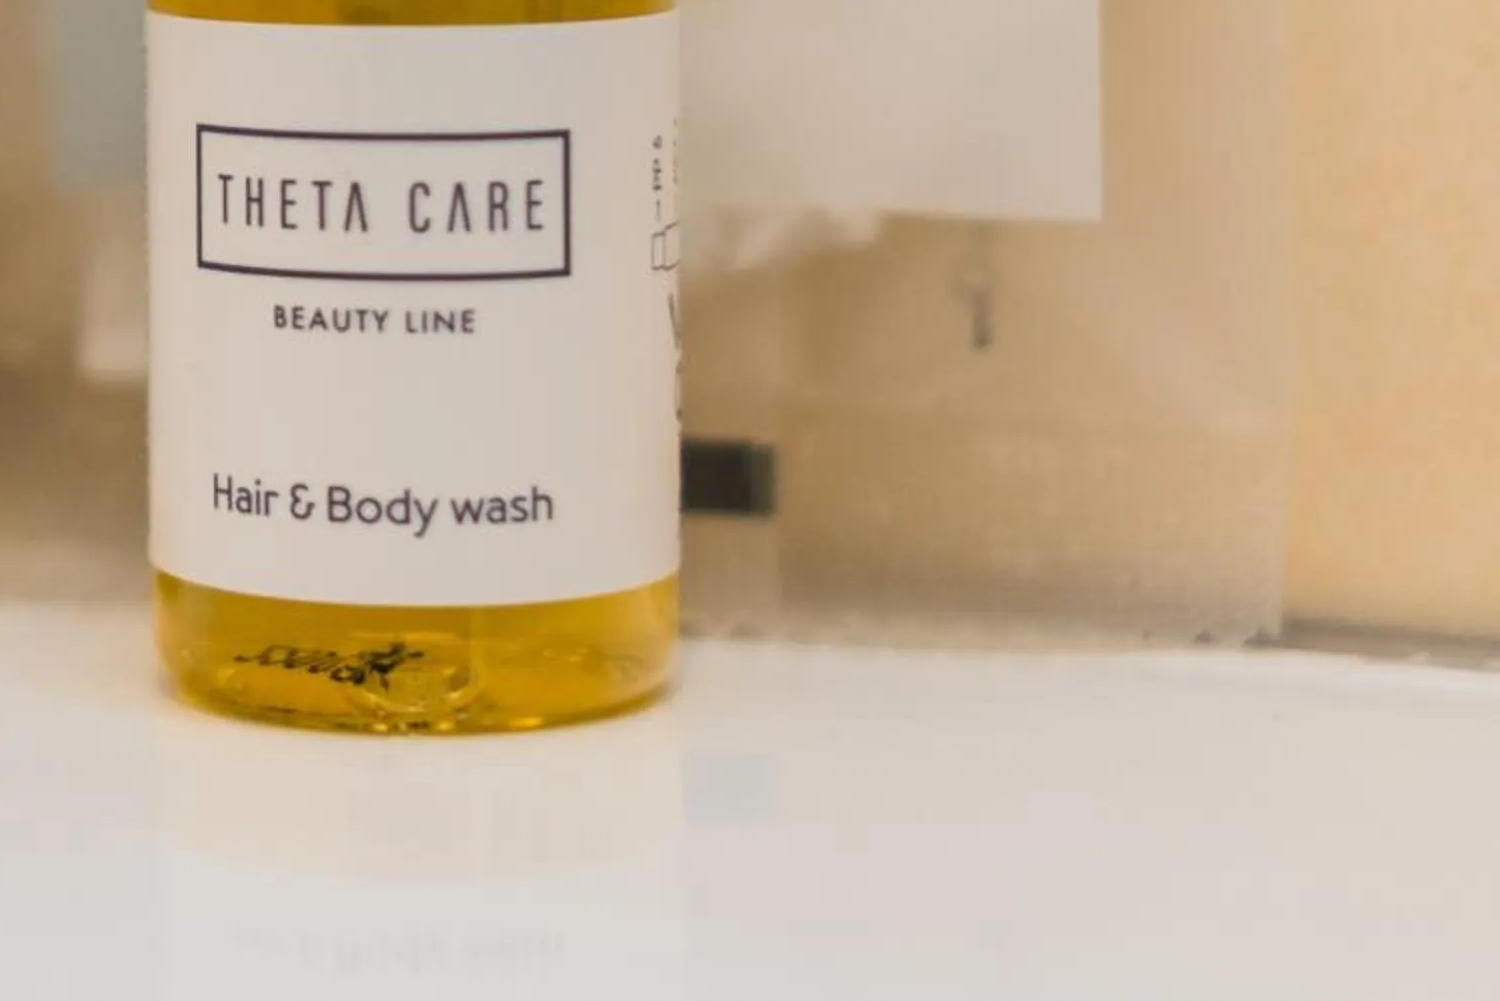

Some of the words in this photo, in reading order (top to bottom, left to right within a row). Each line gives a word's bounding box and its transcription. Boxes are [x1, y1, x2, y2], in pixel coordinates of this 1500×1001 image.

[217, 173, 369, 233] THETA
[408, 179, 545, 234] CARE
[273, 304, 389, 334] BEAUTY
[404, 309, 476, 334] LINE
[213, 472, 280, 517] Hair
[289, 483, 315, 520] &
[327, 485, 439, 539] Body
[450, 485, 554, 525] wash
